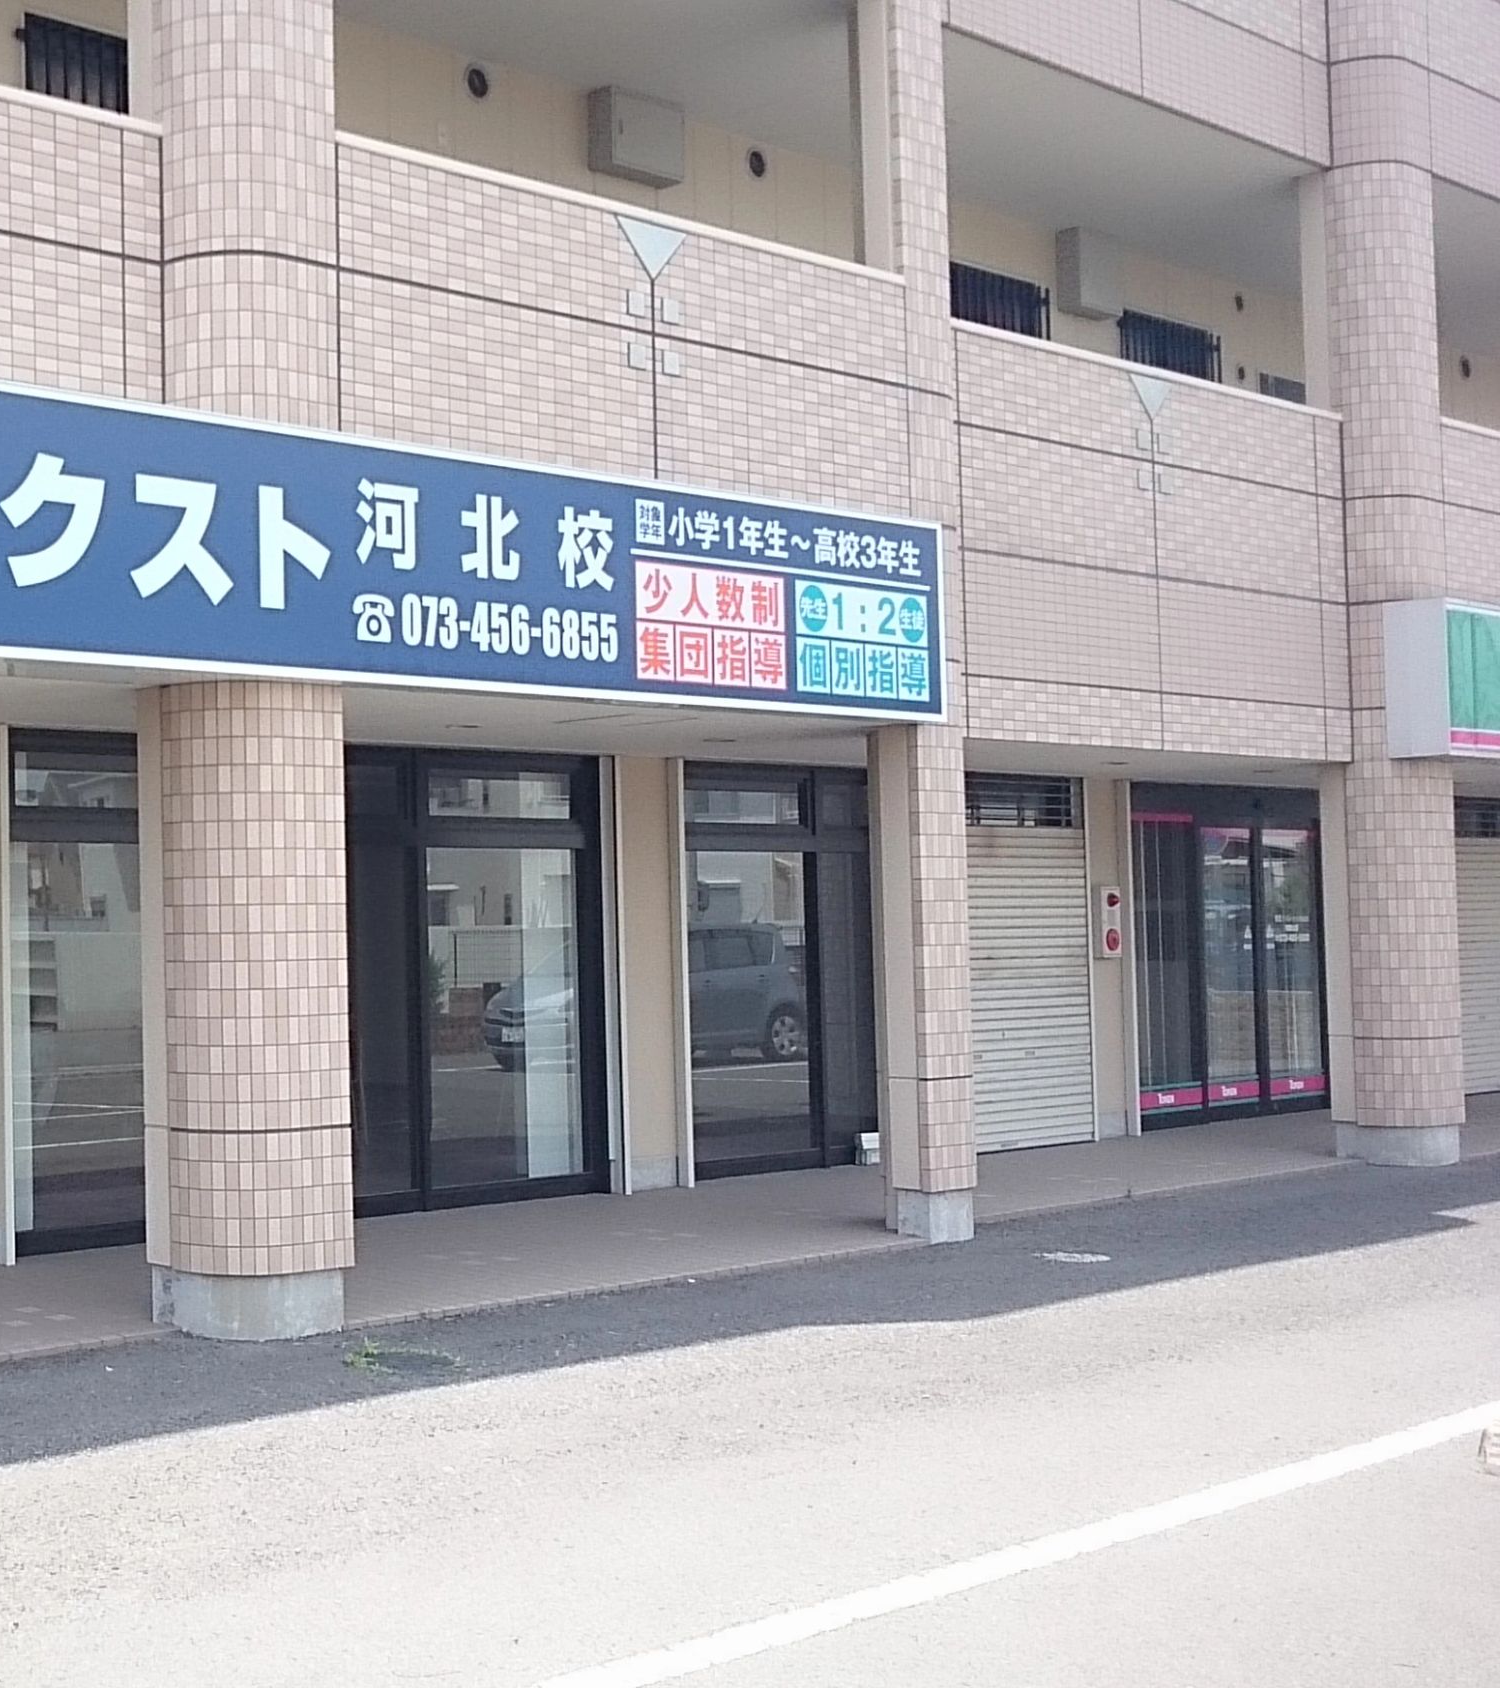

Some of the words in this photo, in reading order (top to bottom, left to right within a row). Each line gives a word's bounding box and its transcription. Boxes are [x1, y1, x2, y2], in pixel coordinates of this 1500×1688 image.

[355, 477, 615, 592] 河北校
[643, 568, 779, 626] 少人数制
[401, 593, 619, 662] 073-456-6855
[638, 626, 783, 684] 集団指導
[799, 642, 927, 696] 個別指導
